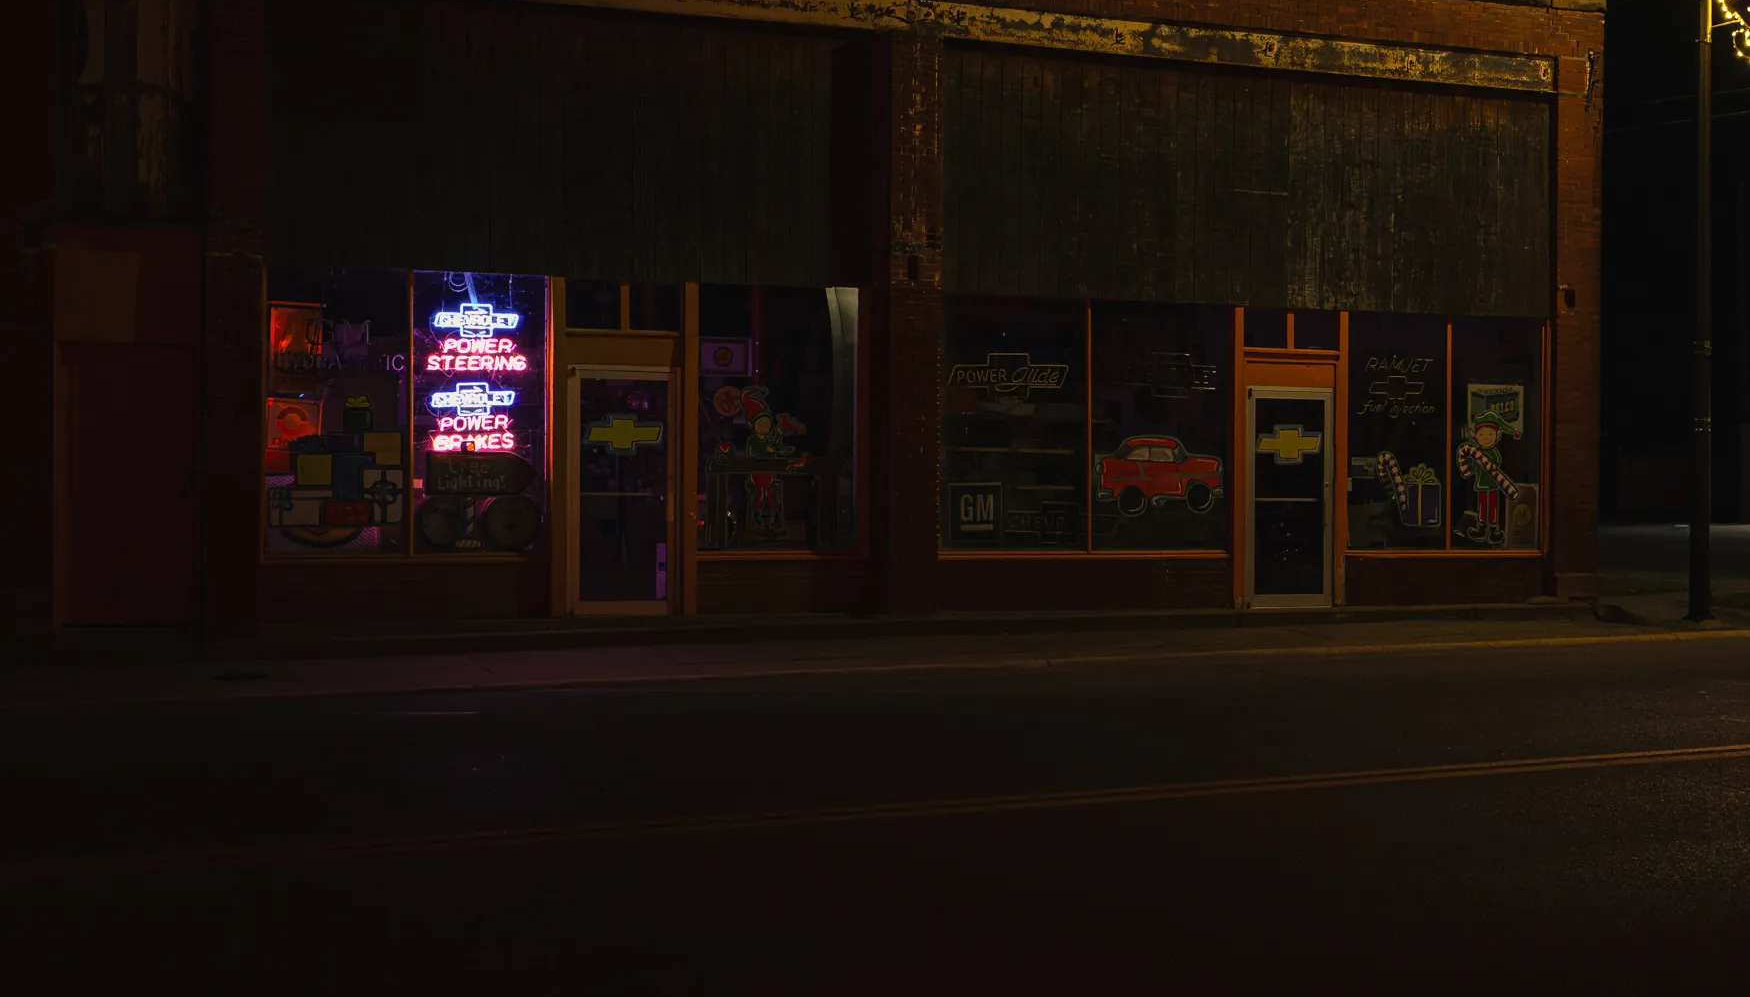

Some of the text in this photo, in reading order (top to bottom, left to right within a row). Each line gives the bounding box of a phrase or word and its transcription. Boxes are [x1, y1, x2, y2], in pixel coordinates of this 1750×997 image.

[444, 338, 513, 354] POWER
[427, 355, 527, 371] STEERING
[1365, 357, 1434, 373] RAMJET
[957, 369, 1007, 383] POWER
[1356, 400, 1388, 415] fuel
[440, 414, 509, 431] POWER
[960, 493, 994, 522] GM
